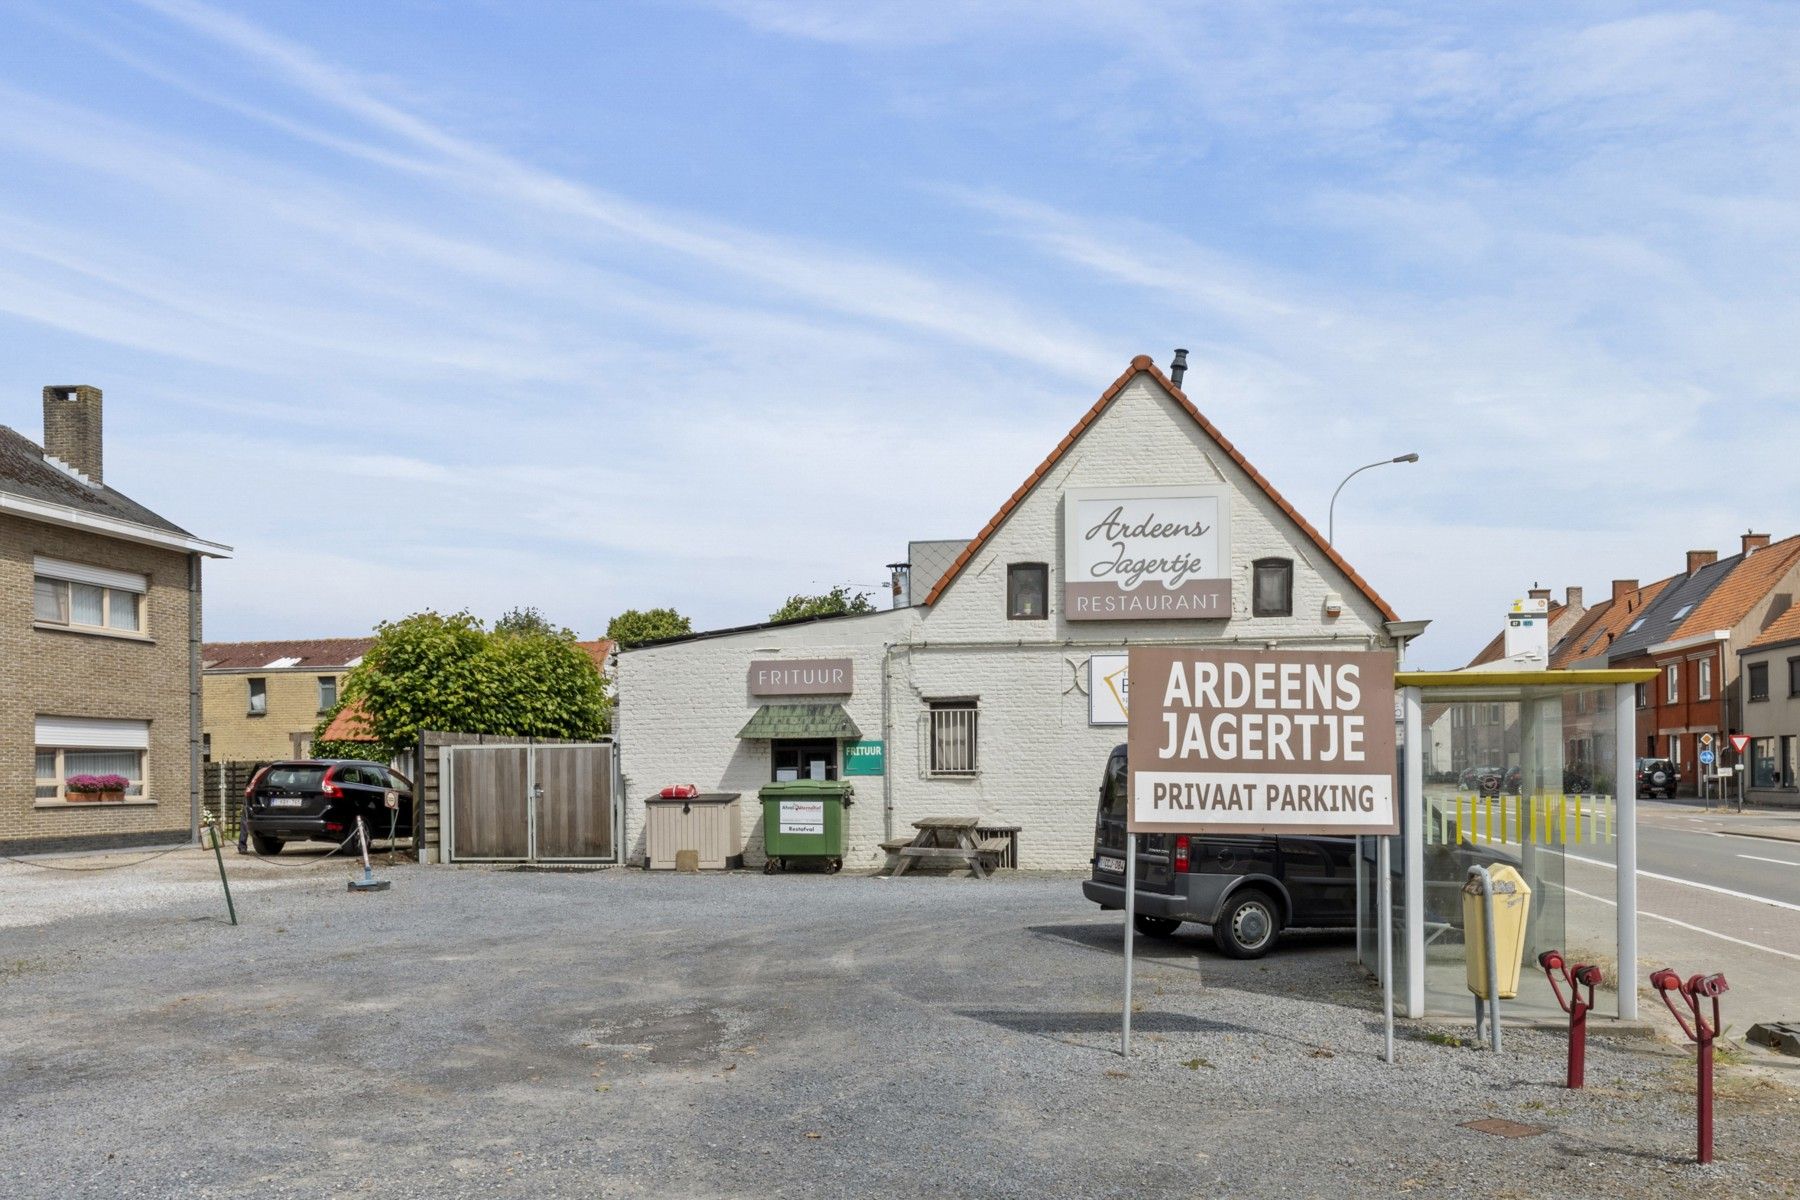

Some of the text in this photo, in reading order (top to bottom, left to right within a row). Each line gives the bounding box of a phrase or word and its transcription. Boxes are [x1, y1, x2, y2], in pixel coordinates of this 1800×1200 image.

[1085, 506, 1210, 541] Ardeens
[1090, 541, 1202, 587] Jagertje
[1077, 593, 1220, 612] RESTAURANT
[759, 668, 843, 685] FRITUUR
[1163, 661, 1361, 710] ARDEENS
[846, 746, 881, 756] FRITUUR
[1158, 712, 1365, 761] JAGERTJE
[1153, 782, 1374, 812] PRIVAAT PARKING
